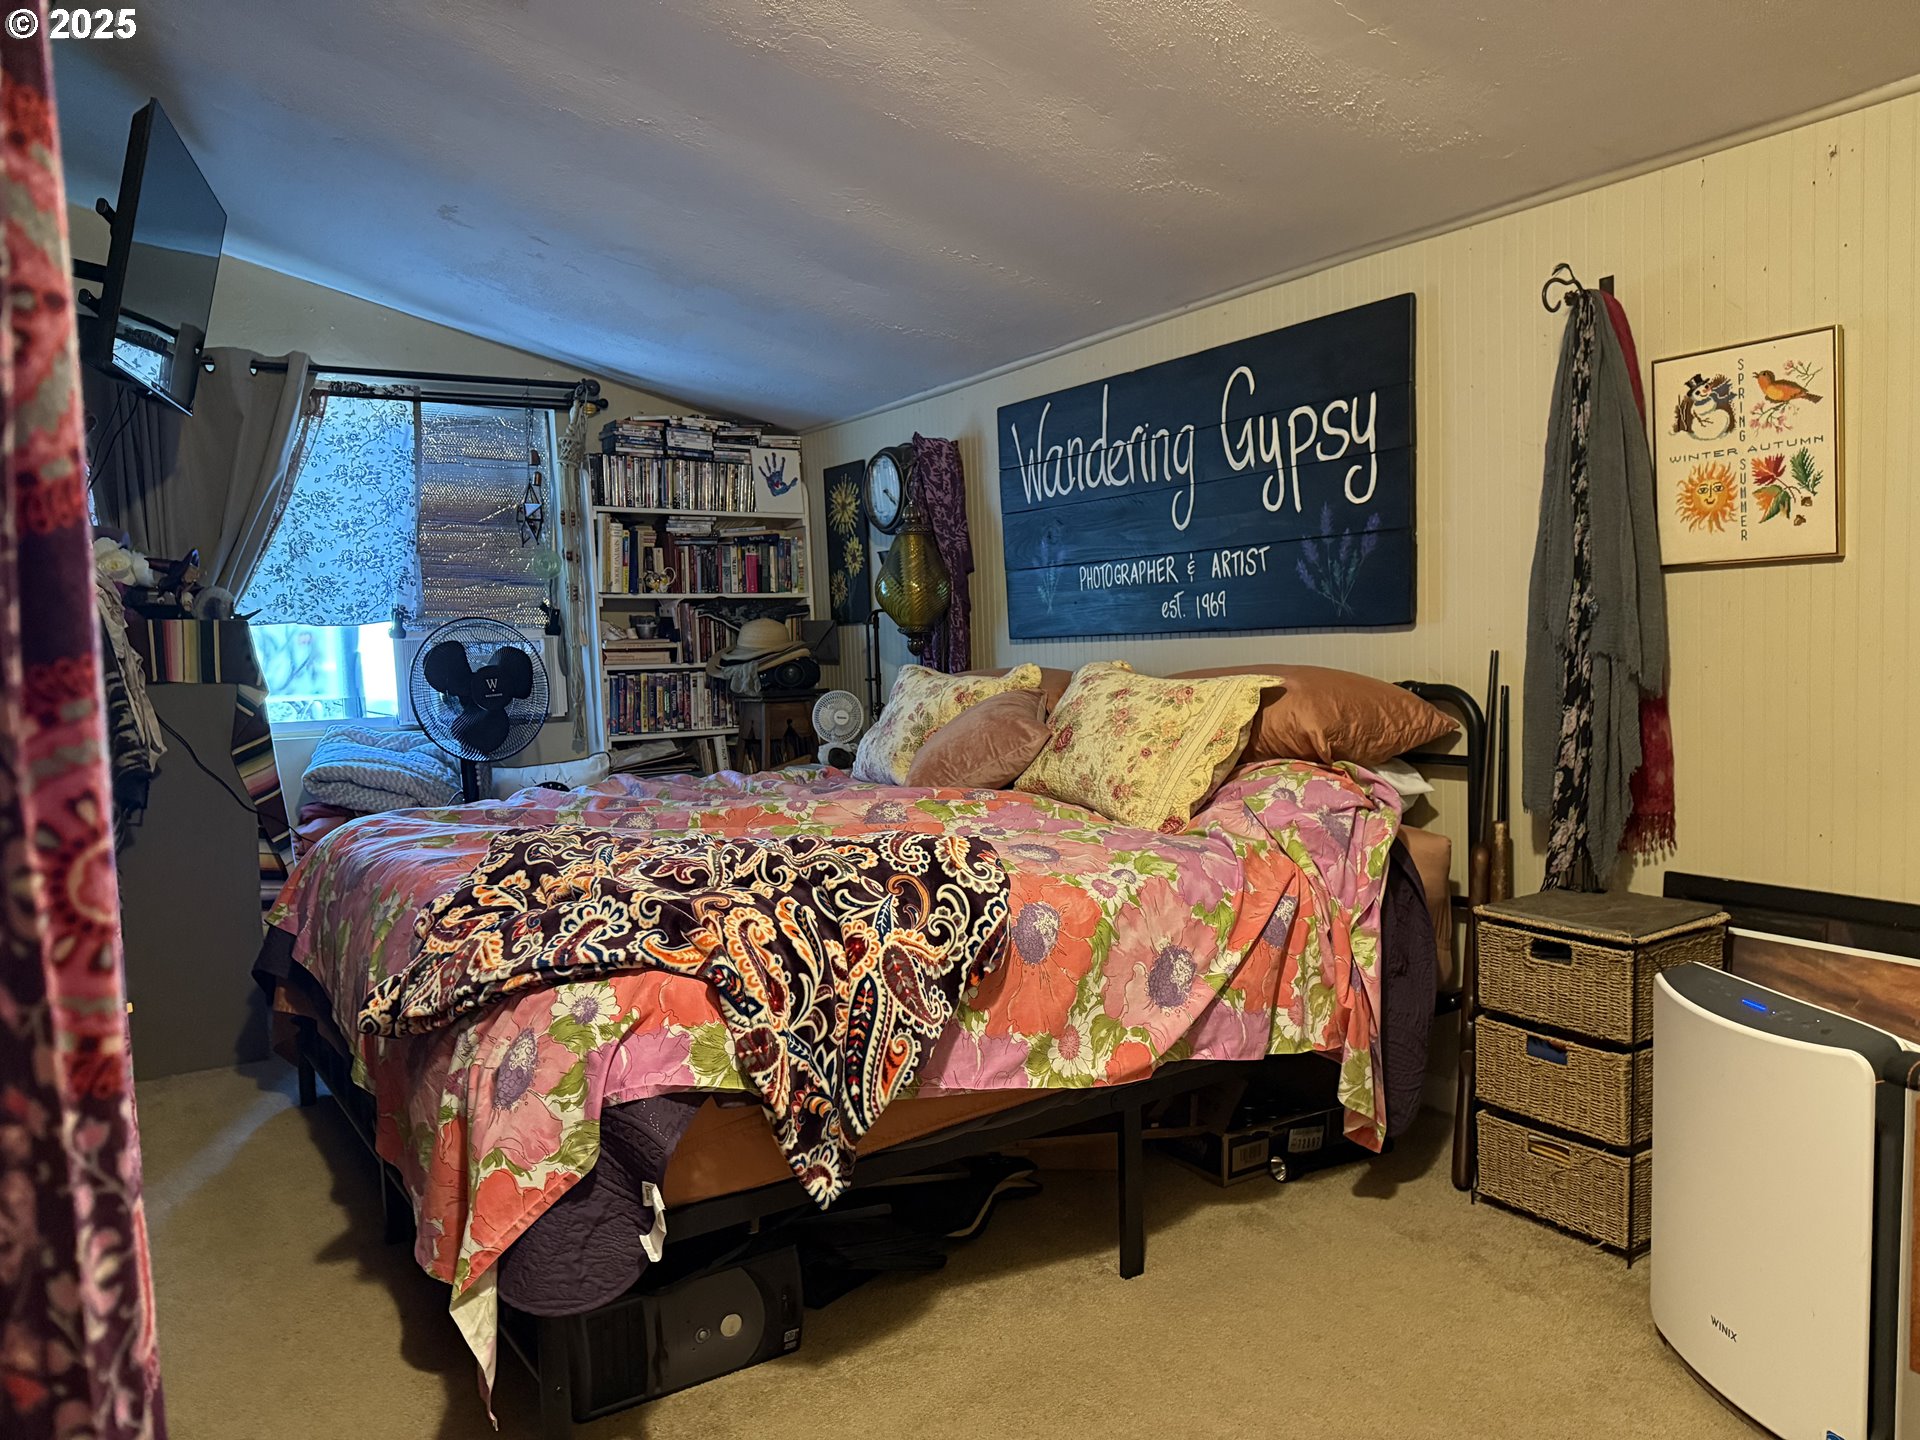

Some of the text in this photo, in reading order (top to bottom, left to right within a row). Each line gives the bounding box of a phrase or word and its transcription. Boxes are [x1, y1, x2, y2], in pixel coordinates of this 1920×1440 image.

[1737, 358, 1746, 442] SPRING
[1011, 365, 1378, 532] Wandering Gypsy
[1669, 435, 1825, 464] WINTER AUTUMN
[1739, 457, 1748, 542] SUMMER
[1079, 545, 1271, 592] PHOTOGRAPHER & ARTIST
[1161, 589, 1228, 619] est. 1969
[1710, 1314, 1738, 1343] WINIX
